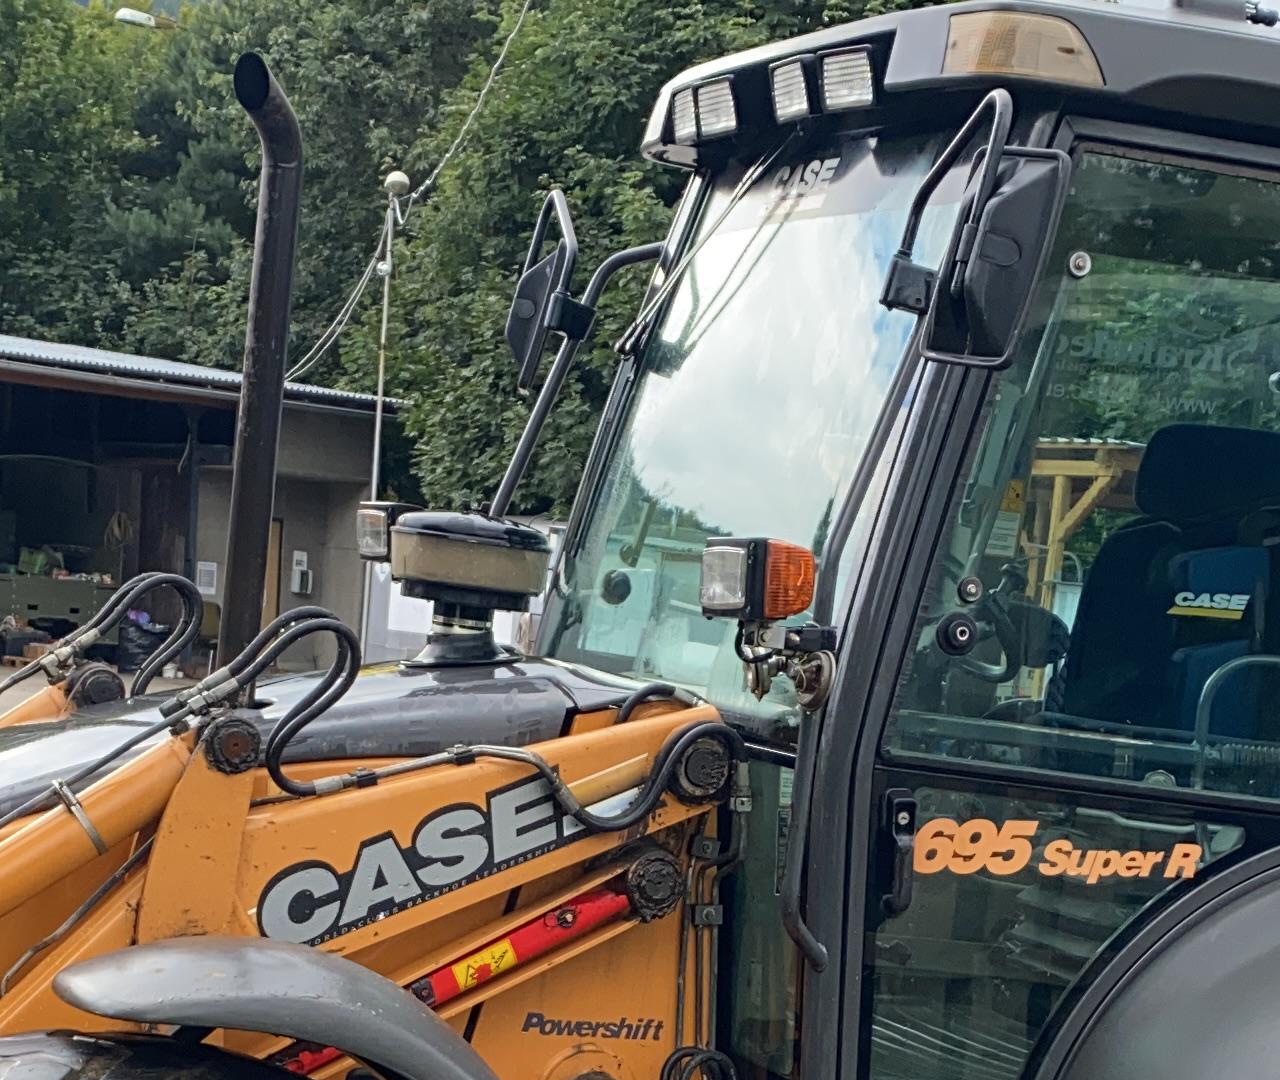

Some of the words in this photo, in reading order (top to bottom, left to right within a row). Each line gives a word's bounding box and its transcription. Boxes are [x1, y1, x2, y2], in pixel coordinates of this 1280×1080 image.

[770, 157, 841, 198] CASE
[1174, 591, 1251, 611] CASE
[261, 776, 557, 945] CASE
[913, 817, 1040, 876] 695
[1038, 839, 1165, 885] Super
[1163, 843, 1203, 879] R
[521, 1011, 664, 1041] Powershift
